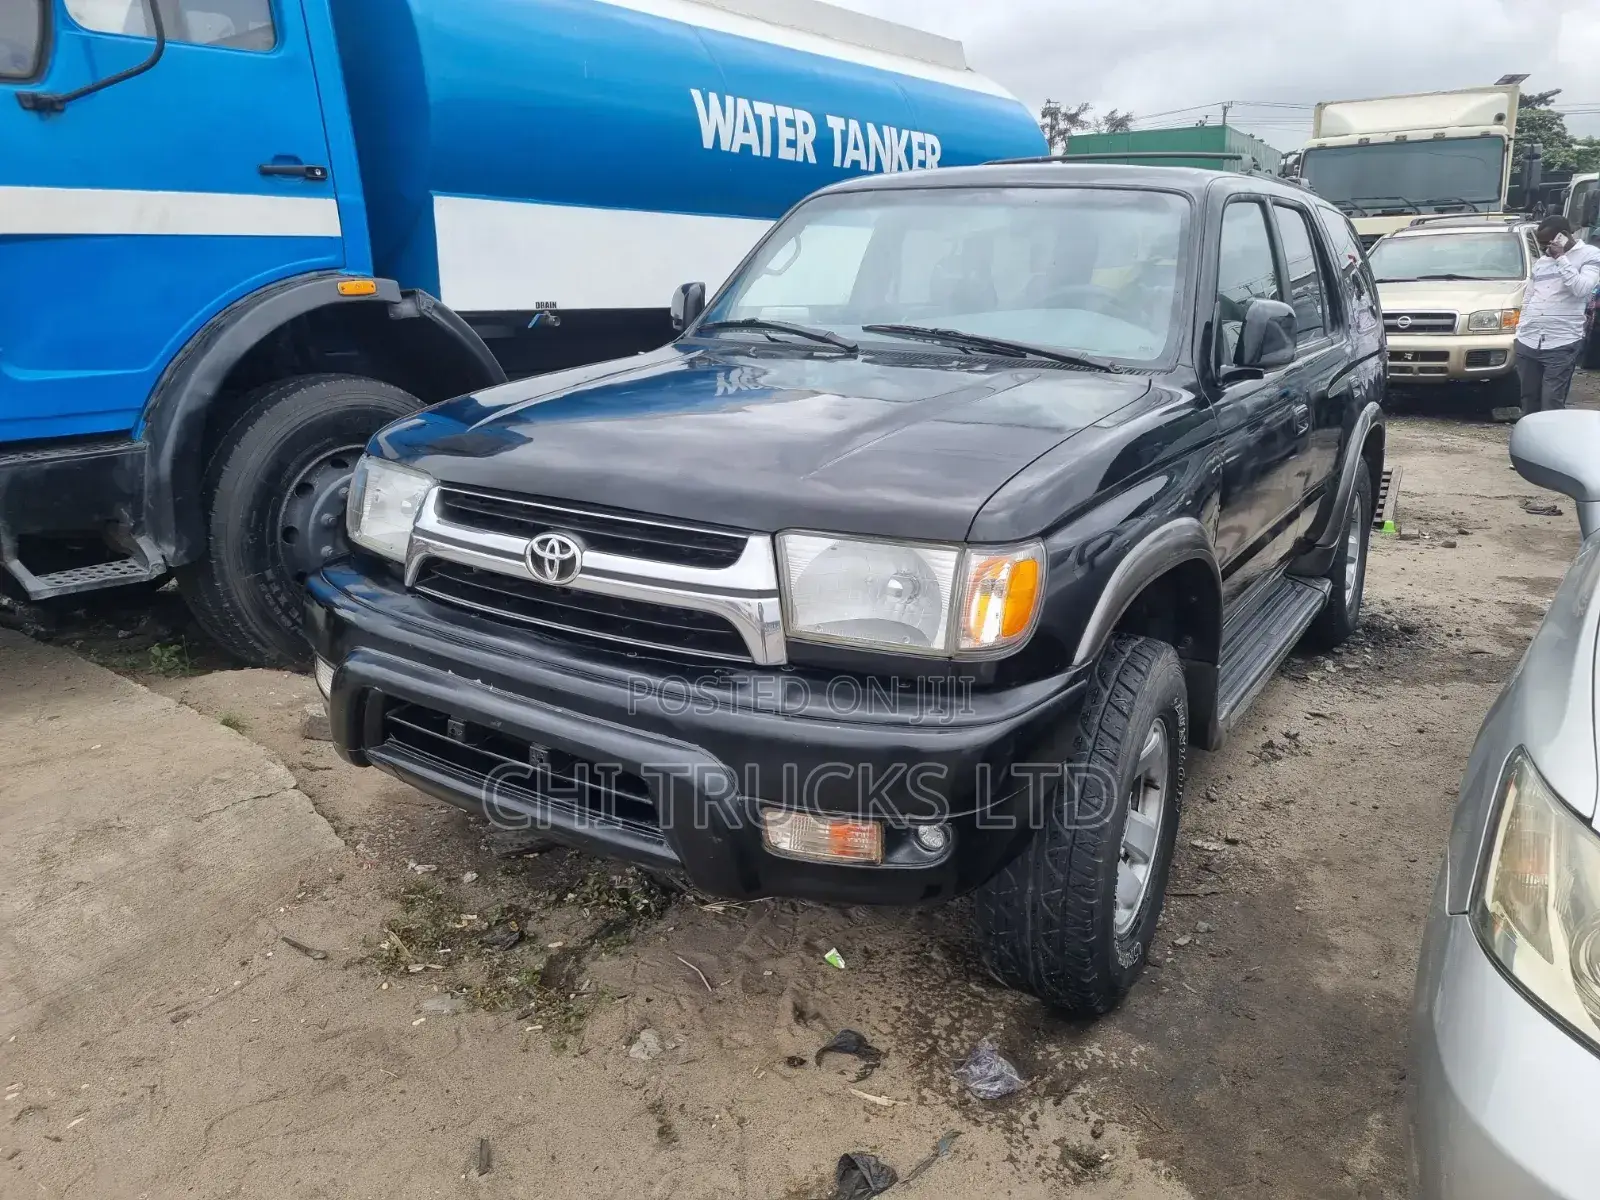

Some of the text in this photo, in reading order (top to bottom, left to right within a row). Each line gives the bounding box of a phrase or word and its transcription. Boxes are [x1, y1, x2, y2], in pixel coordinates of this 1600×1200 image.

[690, 88, 942, 174] WATER TANKER
[535, 301, 557, 309] DRAIN
